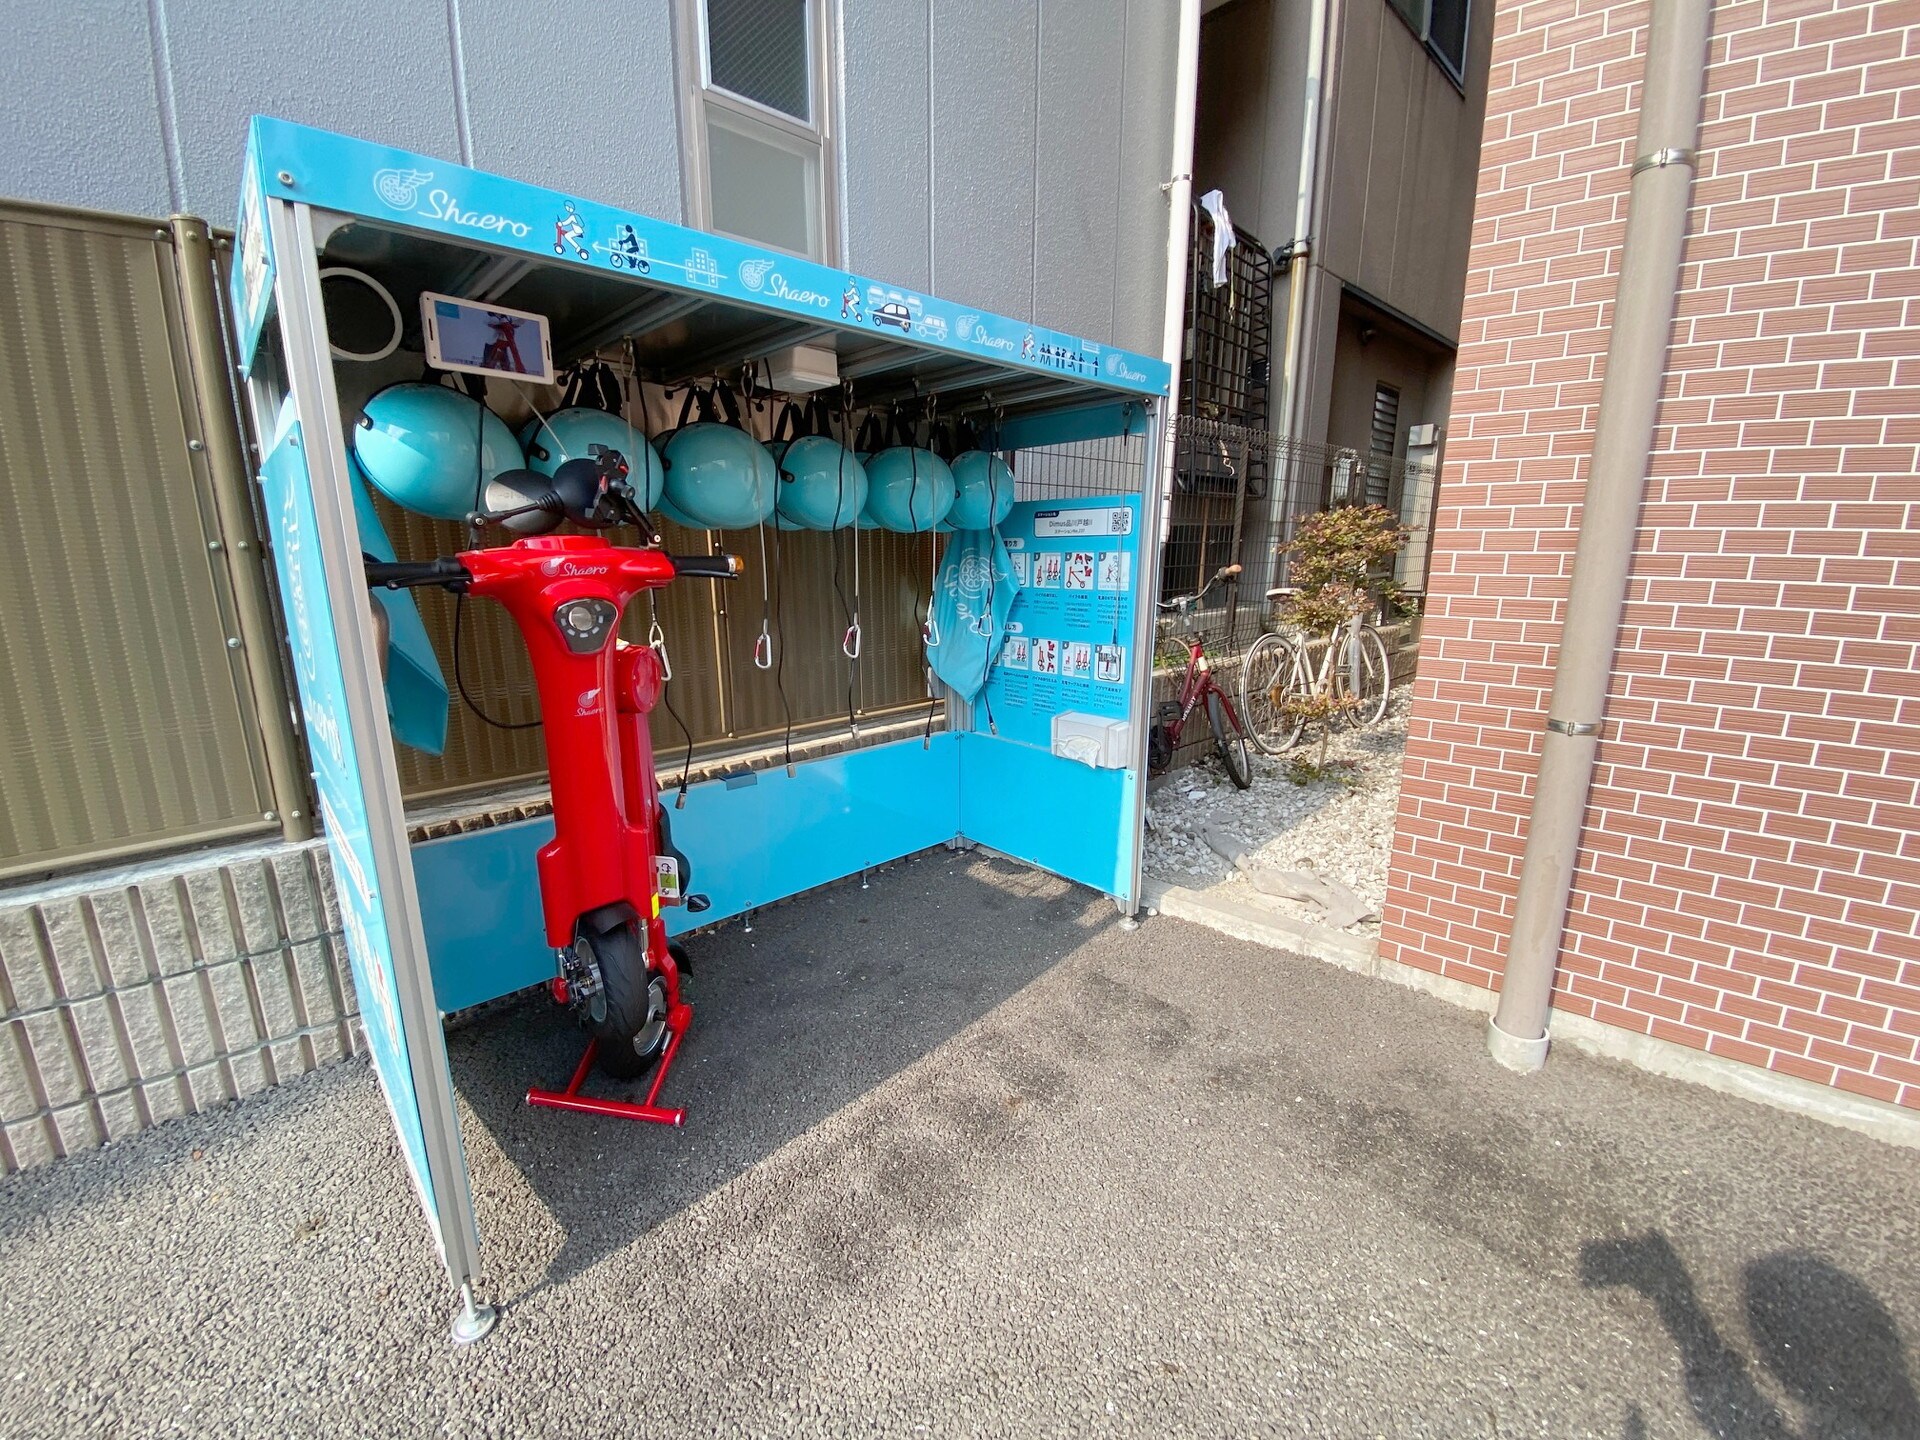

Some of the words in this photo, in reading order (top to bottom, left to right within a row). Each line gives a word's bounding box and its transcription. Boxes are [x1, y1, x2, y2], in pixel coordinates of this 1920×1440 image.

[417, 188, 532, 238] Shaero
[764, 272, 831, 309] Shaero
[971, 324, 1016, 352] Shaero
[1116, 361, 1147, 383] Shaero
[559, 562, 608, 577] Shaero
